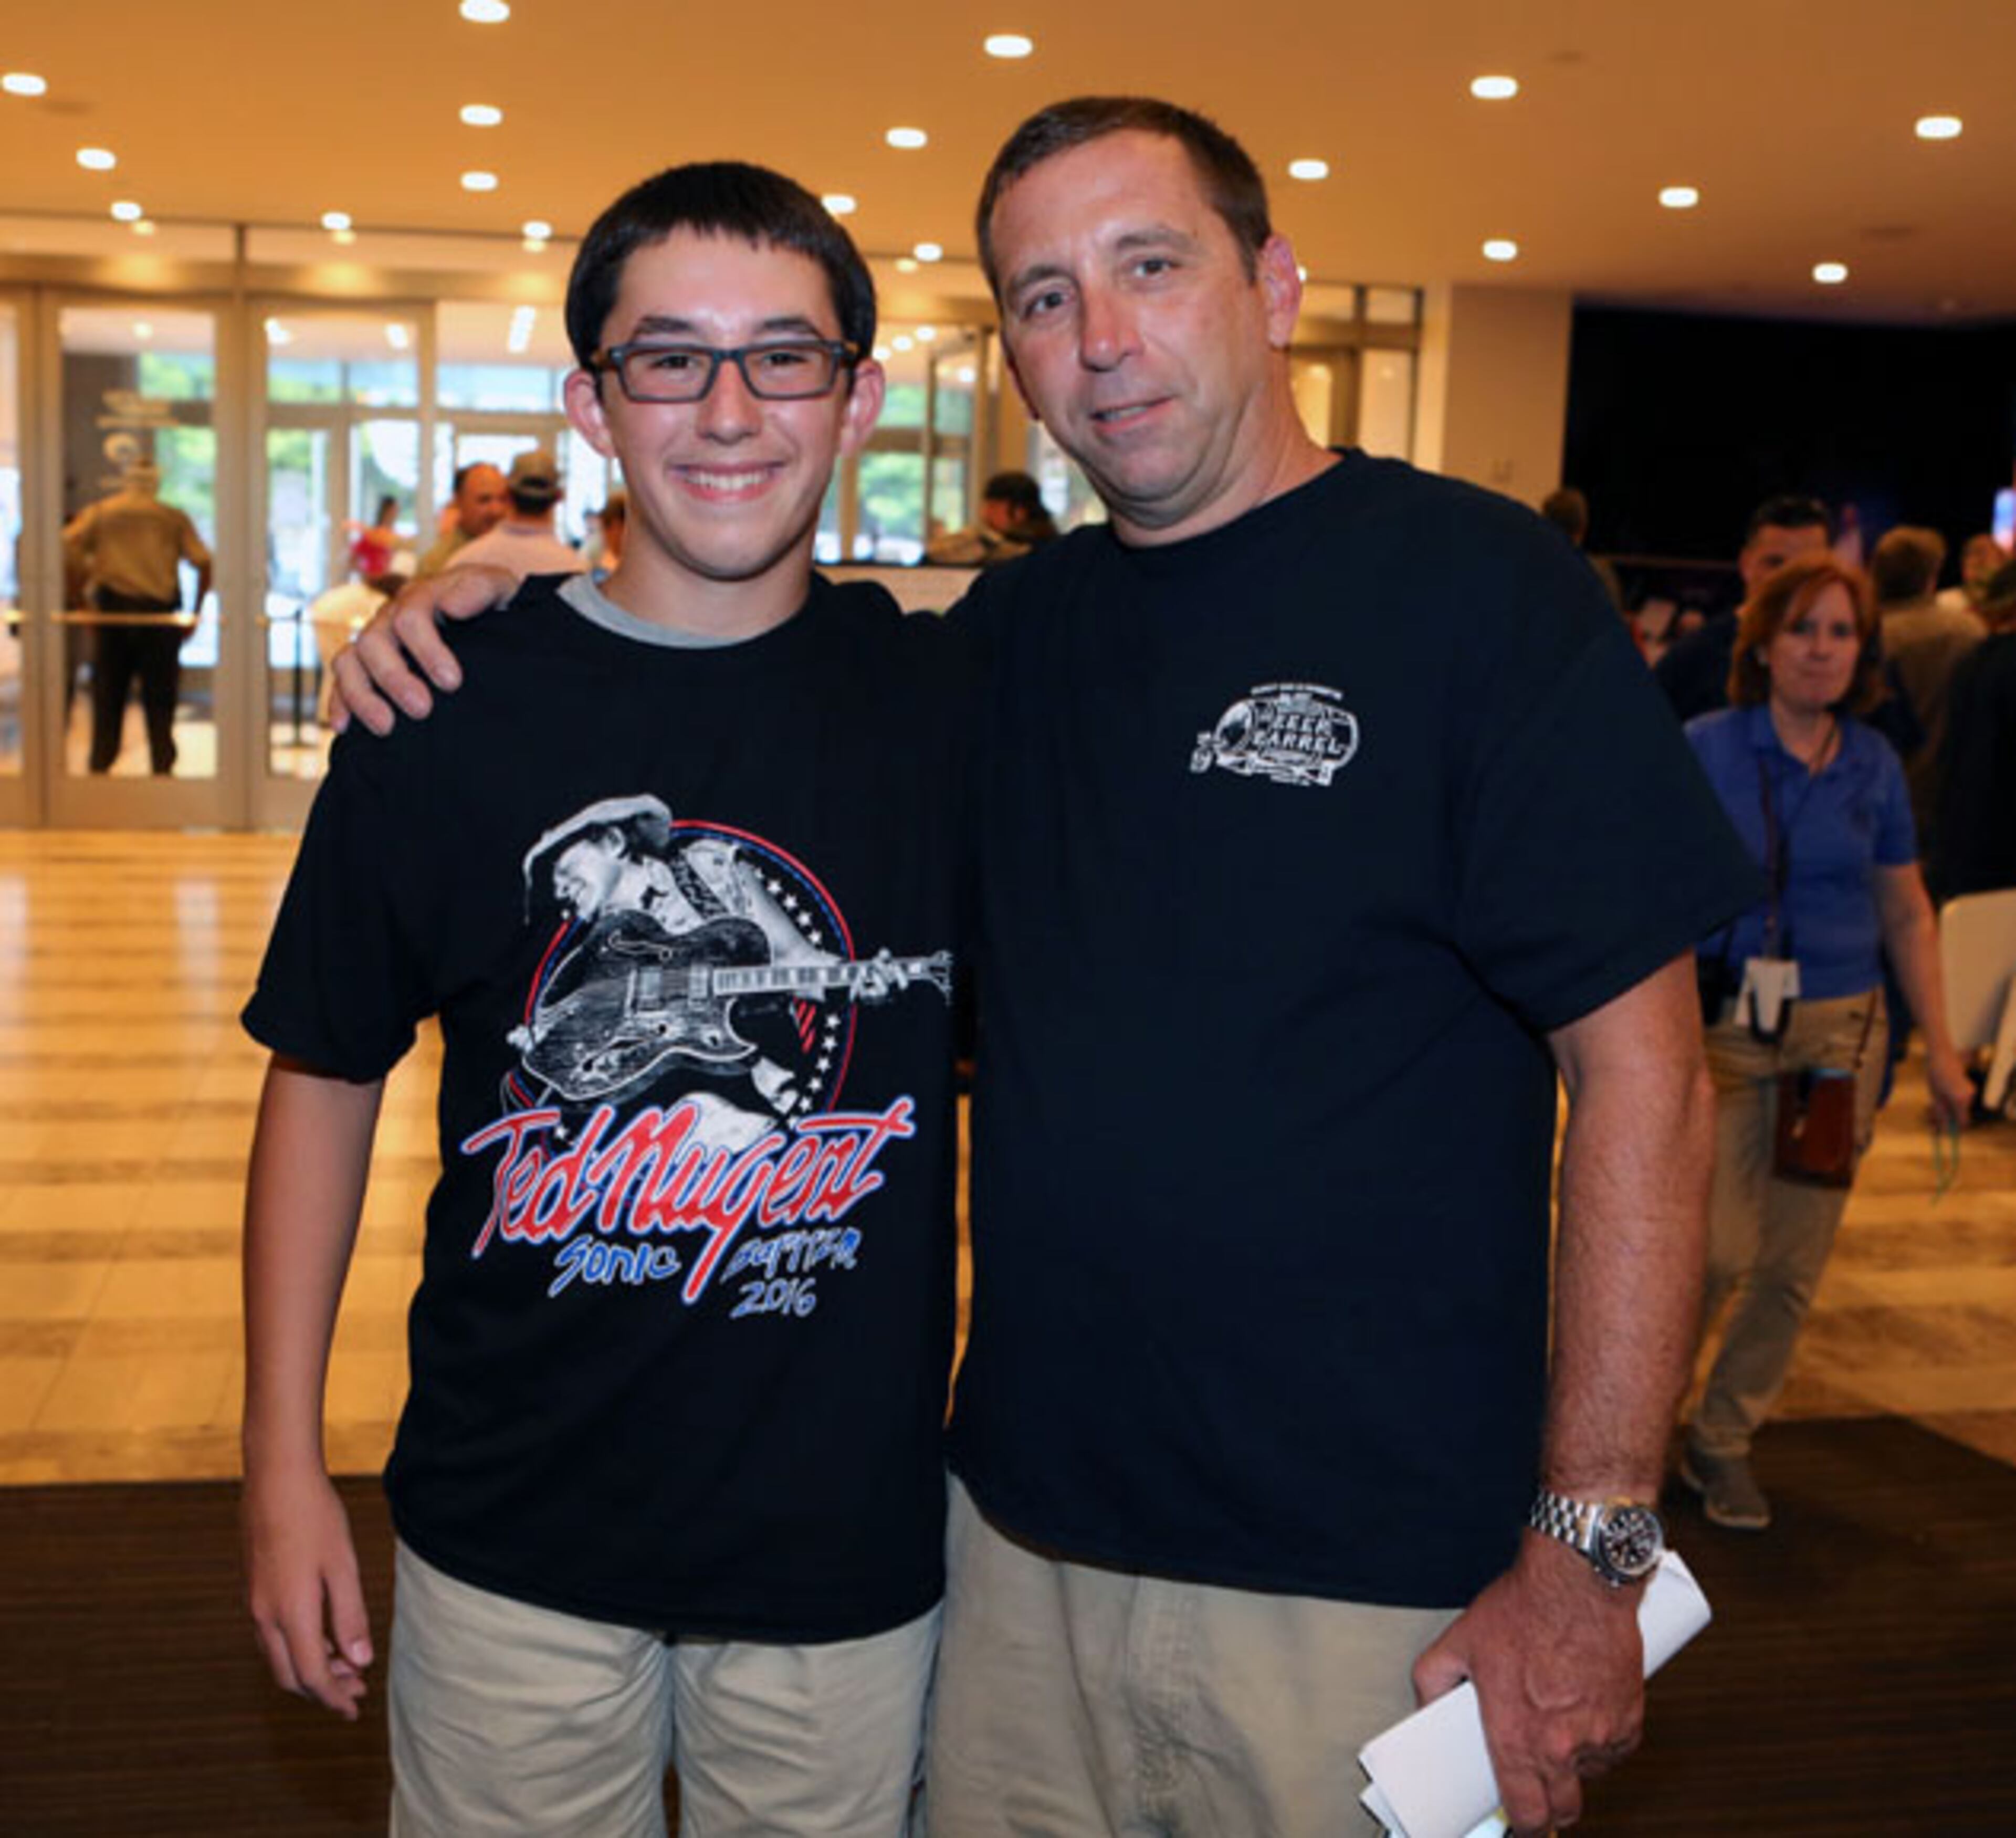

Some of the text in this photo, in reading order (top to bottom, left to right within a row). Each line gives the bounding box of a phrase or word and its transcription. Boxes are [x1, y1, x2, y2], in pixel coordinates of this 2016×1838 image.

[460, 1095, 916, 1303] Ted Nugent
[730, 1278, 816, 1318] 2016
